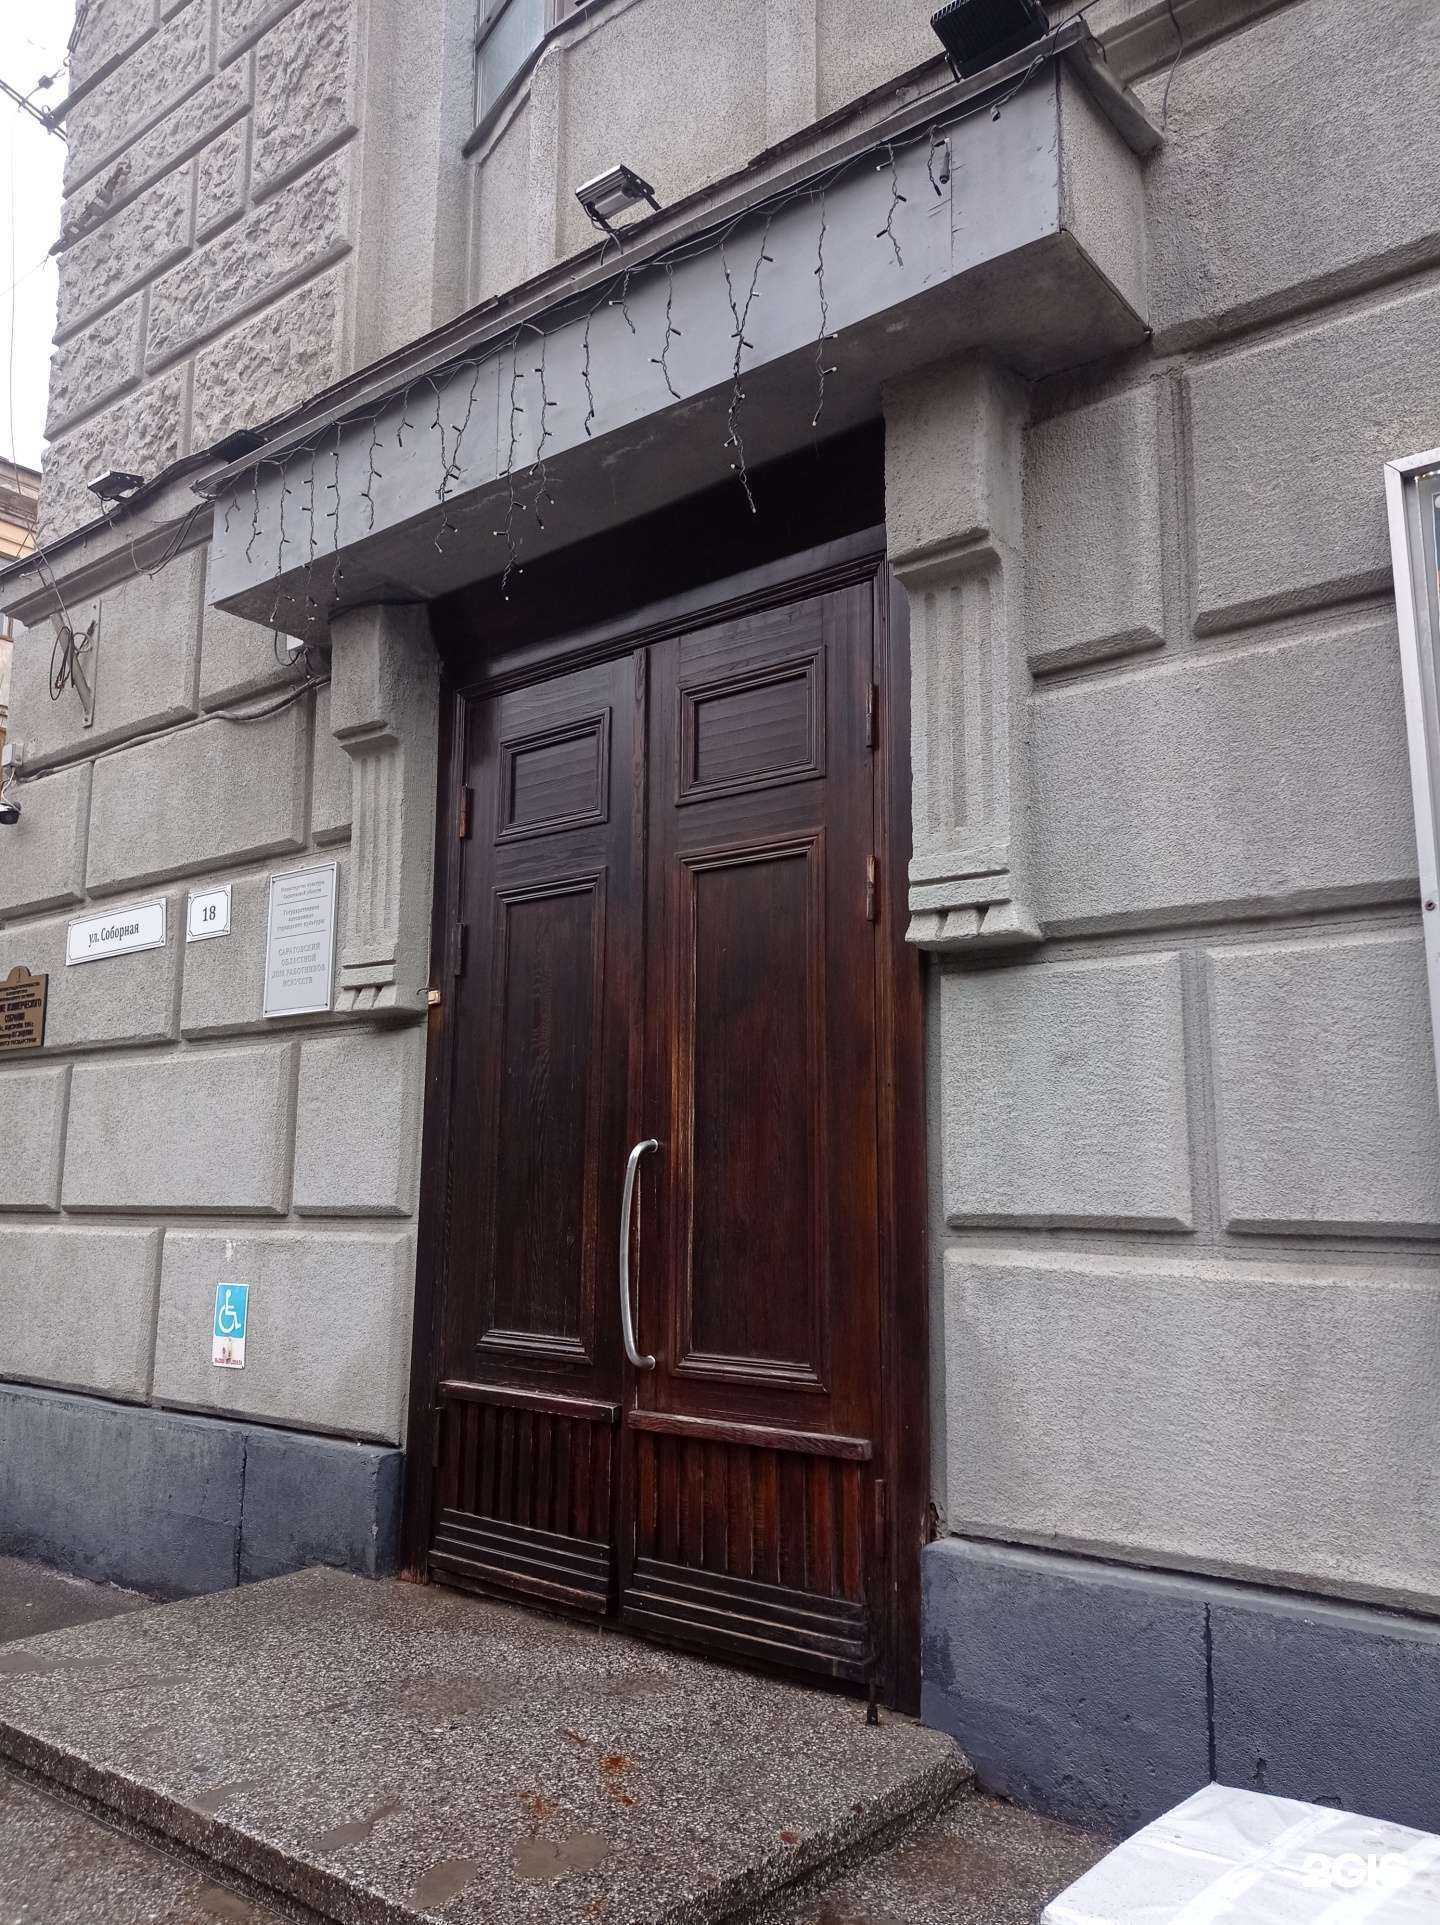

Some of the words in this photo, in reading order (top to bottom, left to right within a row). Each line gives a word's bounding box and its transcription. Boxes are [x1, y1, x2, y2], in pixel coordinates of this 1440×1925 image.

[202, 905, 217, 922] 18
[88, 932, 100, 948] ул.
[100, 922, 140, 942] Соборная
